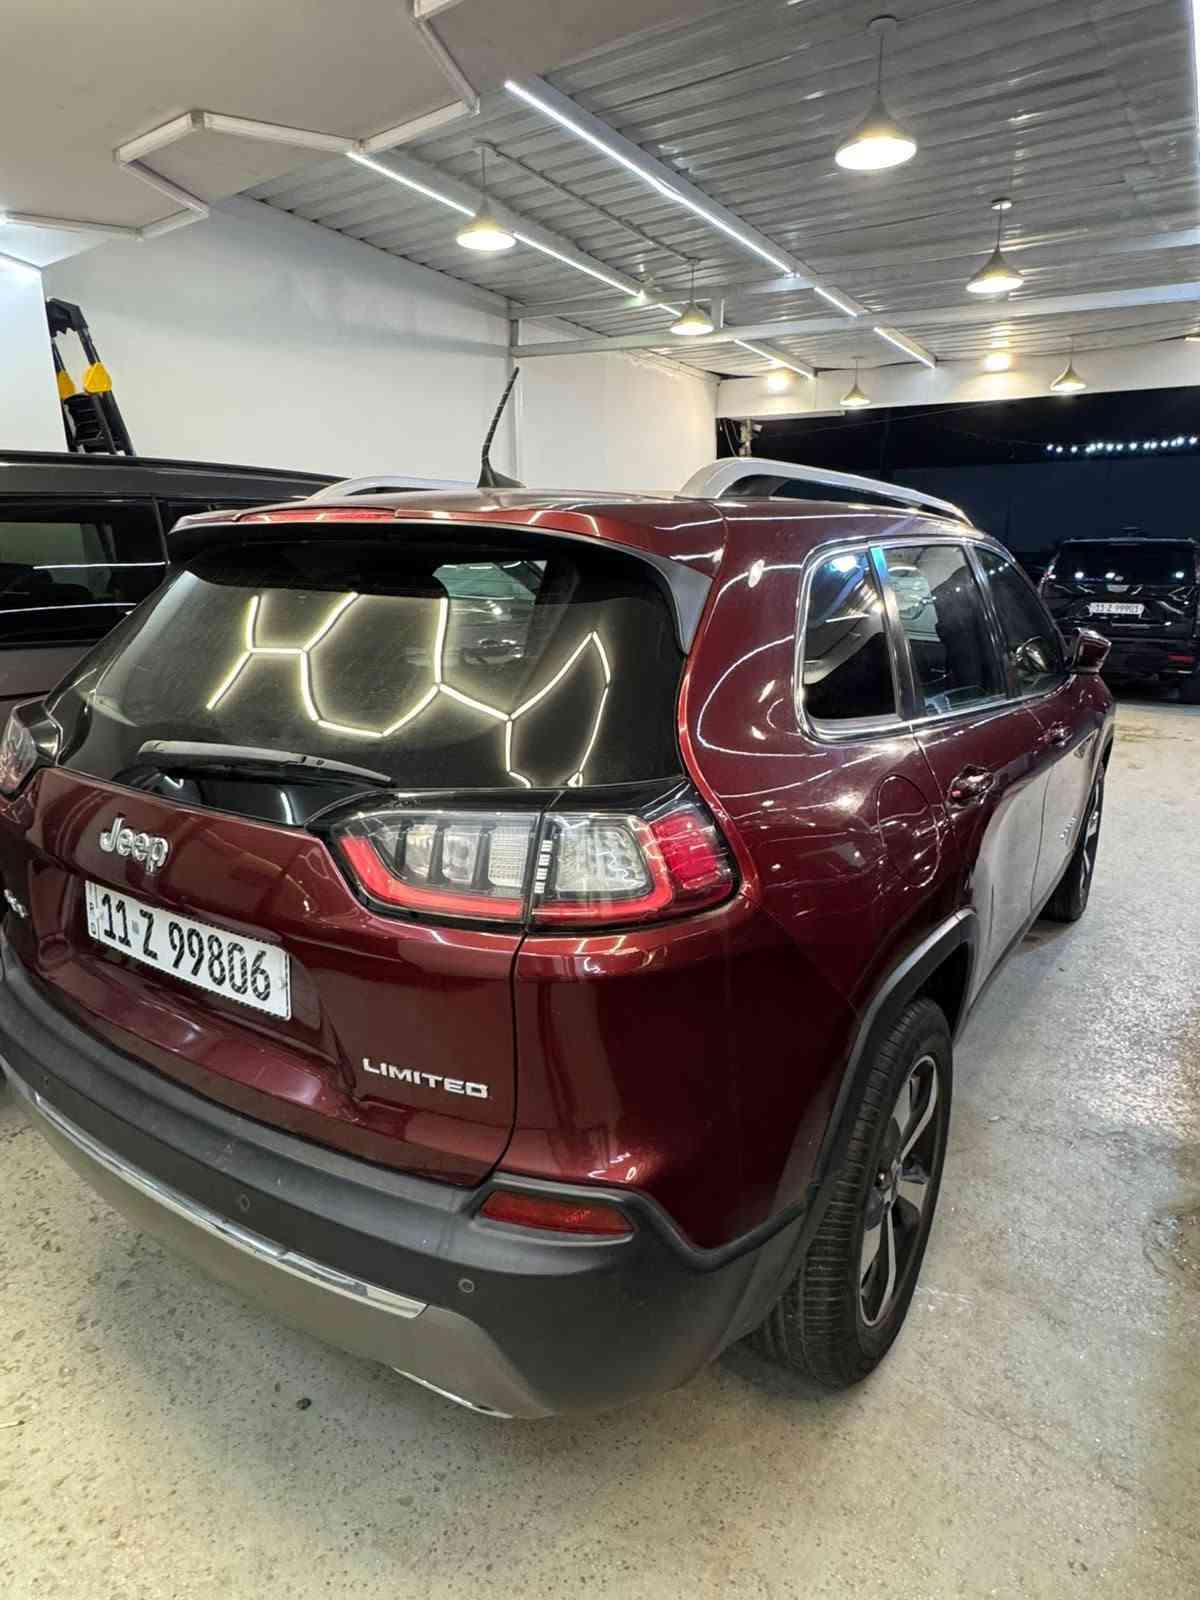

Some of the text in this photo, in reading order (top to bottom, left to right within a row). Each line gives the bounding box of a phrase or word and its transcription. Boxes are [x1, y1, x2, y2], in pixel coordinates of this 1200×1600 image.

[100, 816, 169, 874] Jeep
[102, 893, 132, 947] 11
[140, 909, 159, 960] Z
[168, 921, 271, 1001] 99806
[362, 1057, 488, 1098] LIMITED
